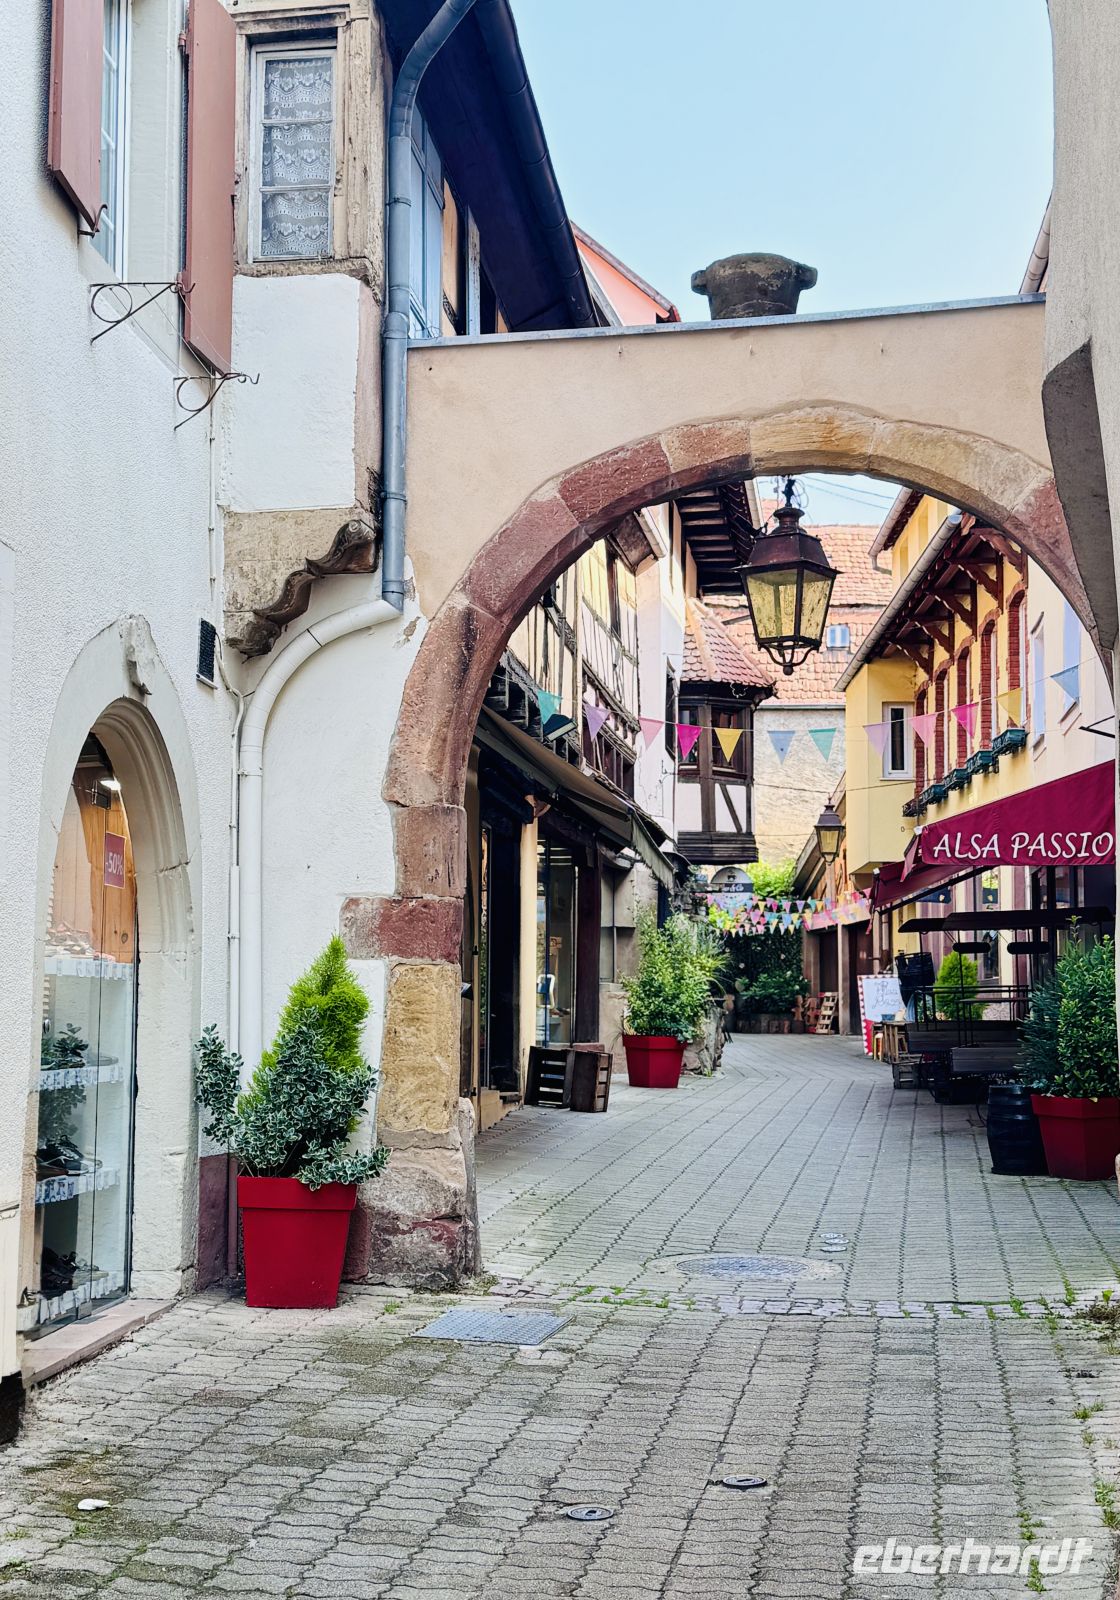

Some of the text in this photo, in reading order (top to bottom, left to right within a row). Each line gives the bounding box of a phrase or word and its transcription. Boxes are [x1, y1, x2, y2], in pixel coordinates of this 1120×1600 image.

[933, 831, 1114, 860] ALSA PASSIO
[105, 851, 123, 876] -50%
